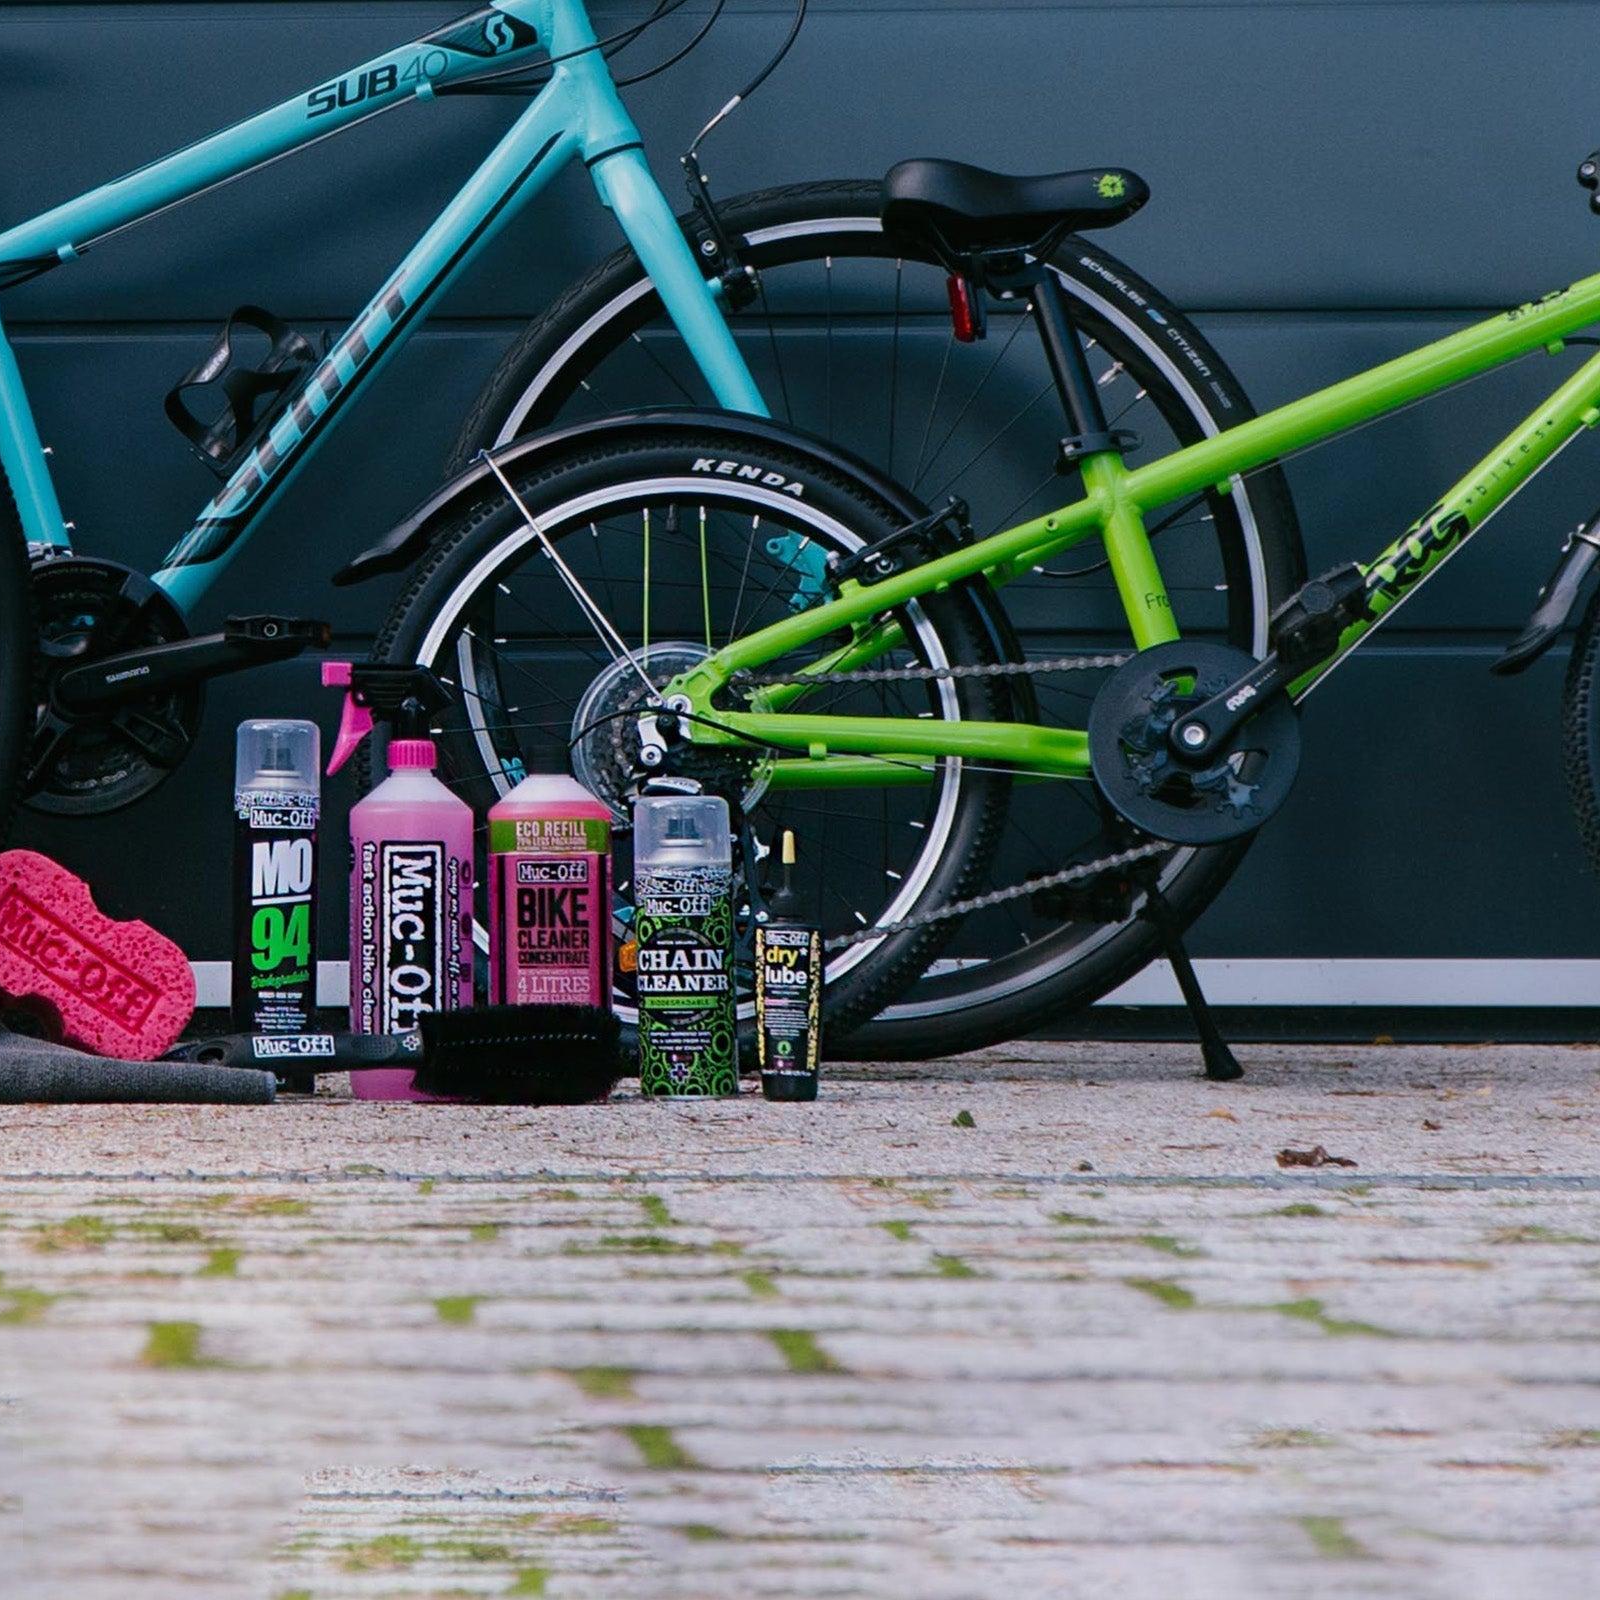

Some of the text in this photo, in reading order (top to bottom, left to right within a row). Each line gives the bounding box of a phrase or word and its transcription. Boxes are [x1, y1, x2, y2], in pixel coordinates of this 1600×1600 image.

[305, 50, 449, 119] SUB 40
[1079, 256, 1213, 378] SCHWALBE CITIZEN
[691, 457, 805, 498] KENDA
[105, 666, 150, 684] SHIMANO
[253, 809, 313, 826] Muc-Off
[516, 820, 587, 837] ECO REFILL
[252, 838, 312, 898] MO
[521, 864, 585, 880] Muc-Off
[517, 887, 589, 929] BIKE
[647, 897, 708, 914] Muc-Off
[251, 904, 310, 971] 94
[362, 842, 376, 1035] fast action bike clean
[518, 930, 590, 949] CLEANER
[518, 951, 590, 965] CONCENTRATE
[639, 949, 725, 971] CHAIN
[766, 945, 799, 968] dry
[518, 975, 590, 994] 4 LITRES
[637, 974, 729, 992] CLEANER
[765, 964, 808, 985] lube
[257, 1037, 330, 1054] Muc-Off
